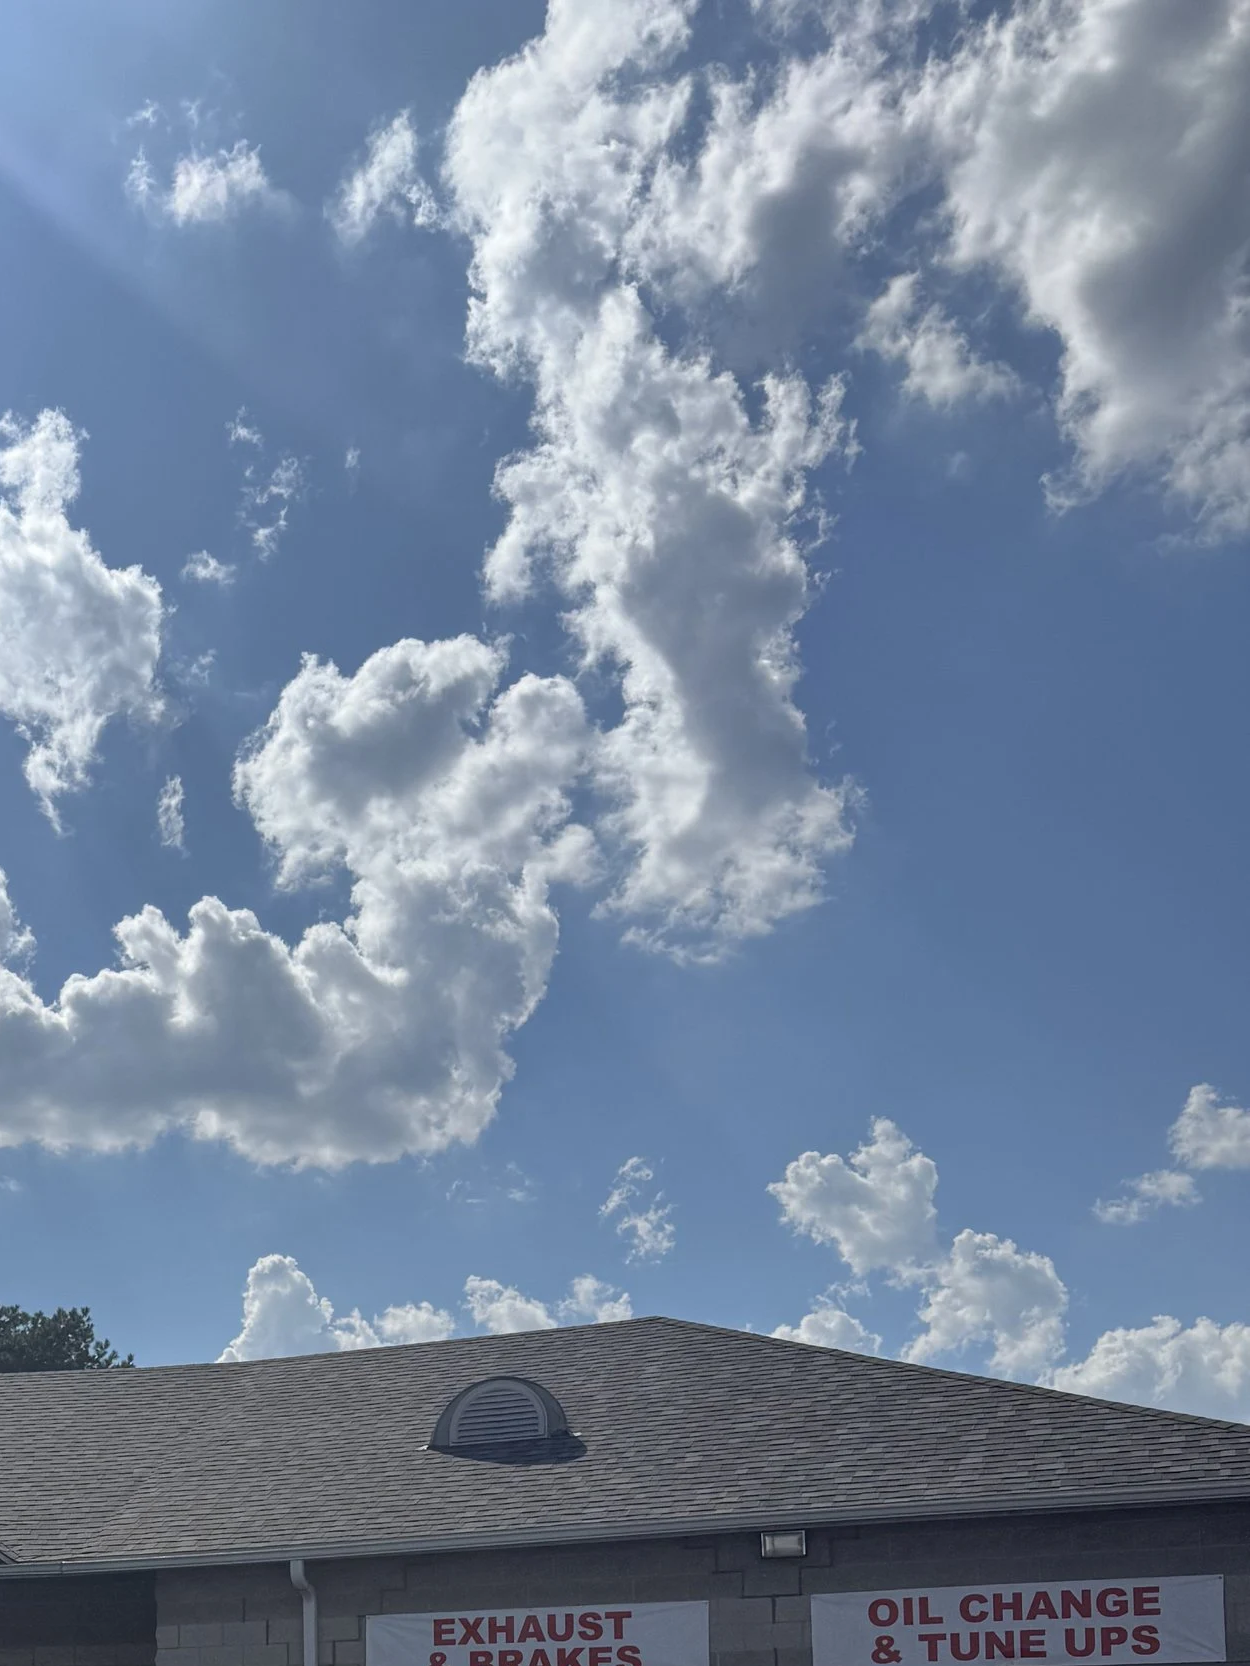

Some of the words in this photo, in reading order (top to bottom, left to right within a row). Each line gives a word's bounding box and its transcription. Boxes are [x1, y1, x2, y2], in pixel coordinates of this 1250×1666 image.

[869, 1597, 943, 1627] OIL
[959, 1586, 1160, 1623] CHANGE
[433, 1611, 632, 1647] EXHAUST
[871, 1635, 902, 1664] &
[918, 1629, 1047, 1661] TUNE
[1064, 1625, 1161, 1658] UPS
